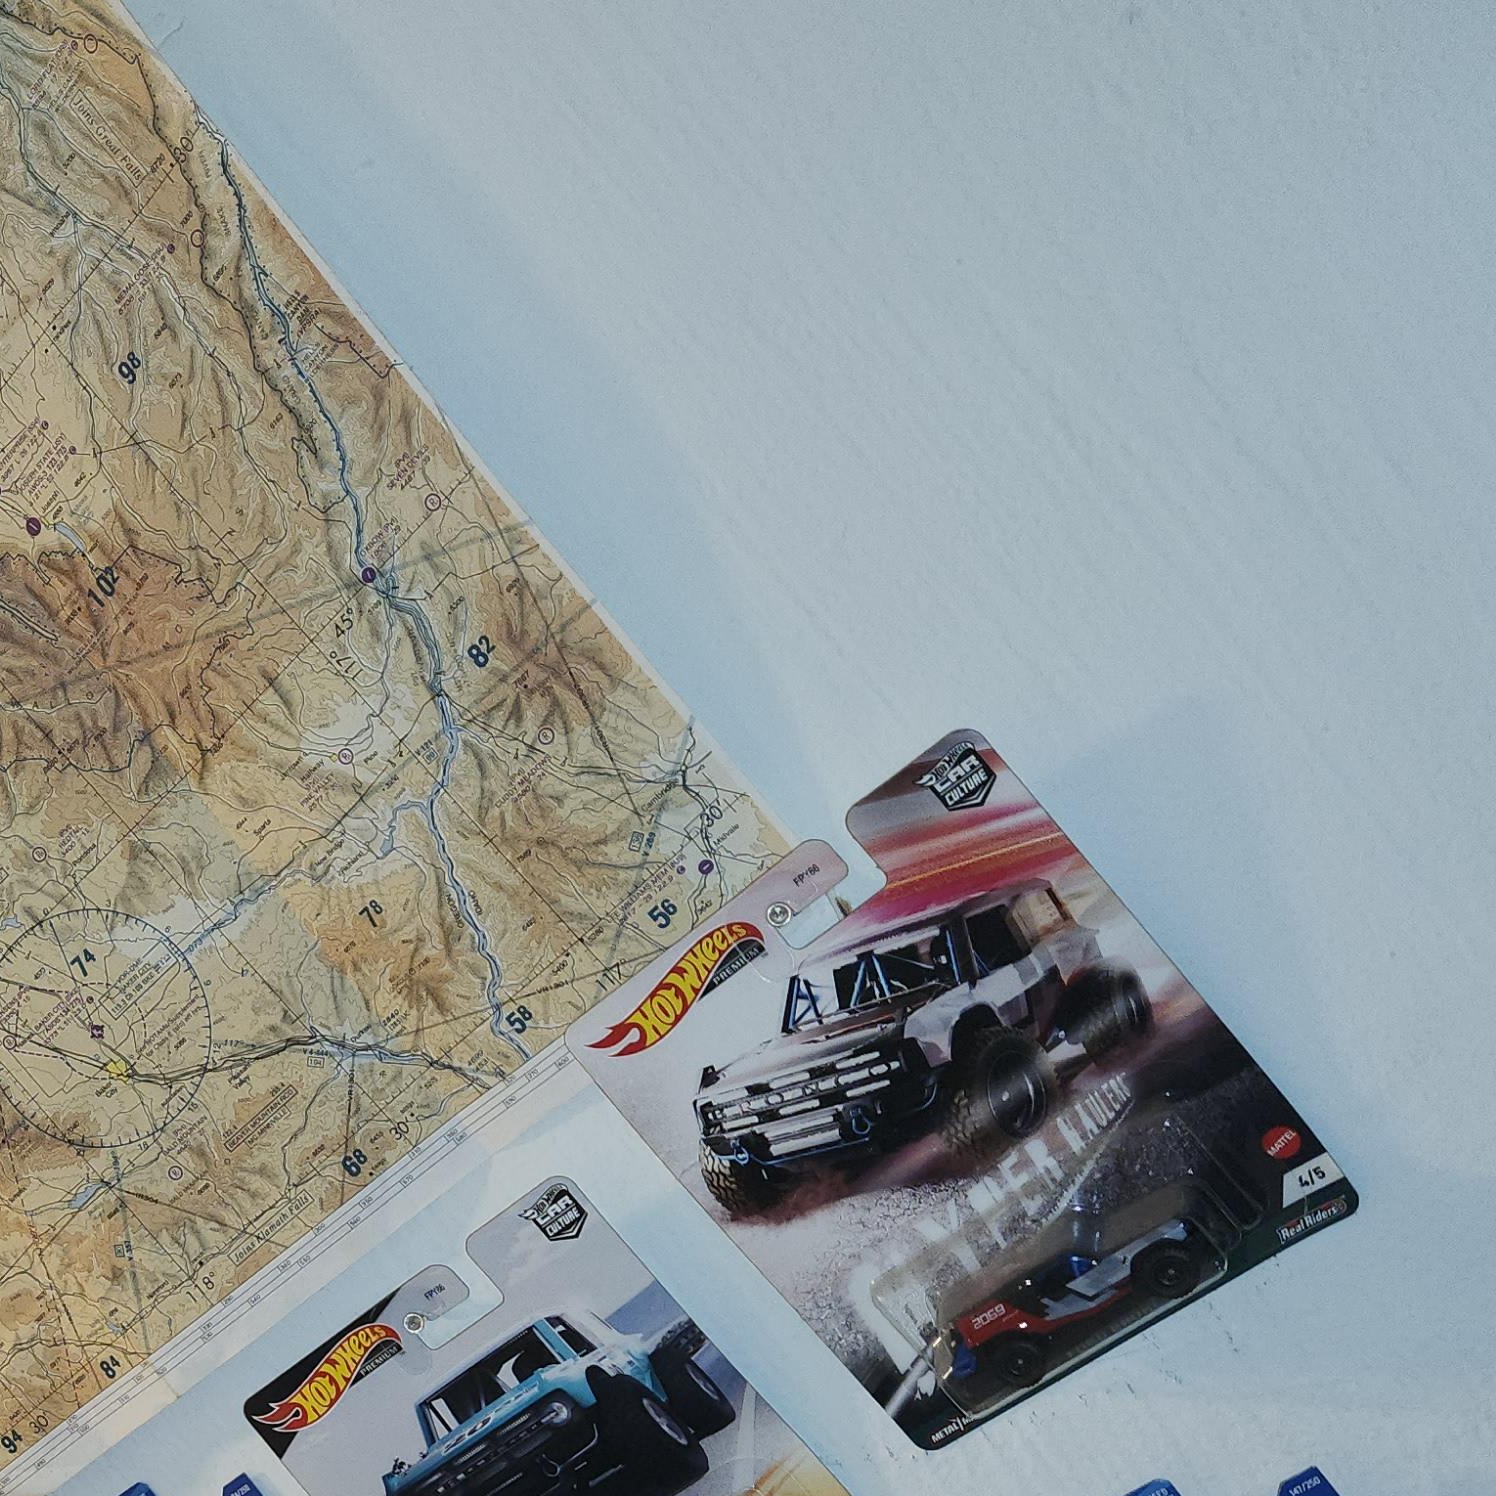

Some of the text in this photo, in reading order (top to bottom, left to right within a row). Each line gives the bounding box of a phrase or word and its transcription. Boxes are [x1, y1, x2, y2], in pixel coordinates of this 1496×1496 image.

[75, 98, 143, 182] Joins Great Falls
[933, 754, 981, 794] CAR
[945, 771, 988, 806] CULTURE
[712, 944, 761, 986] PREMIUM
[1266, 1128, 1298, 1159] MATTEL
[1297, 1165, 1327, 1188] 4/5
[535, 1195, 574, 1223] CAR
[545, 1207, 582, 1239] CULTURE
[1302, 1202, 1339, 1231] Riders
[971, 1303, 1007, 1331] 2069
[360, 1343, 399, 1377] PREMIUM
